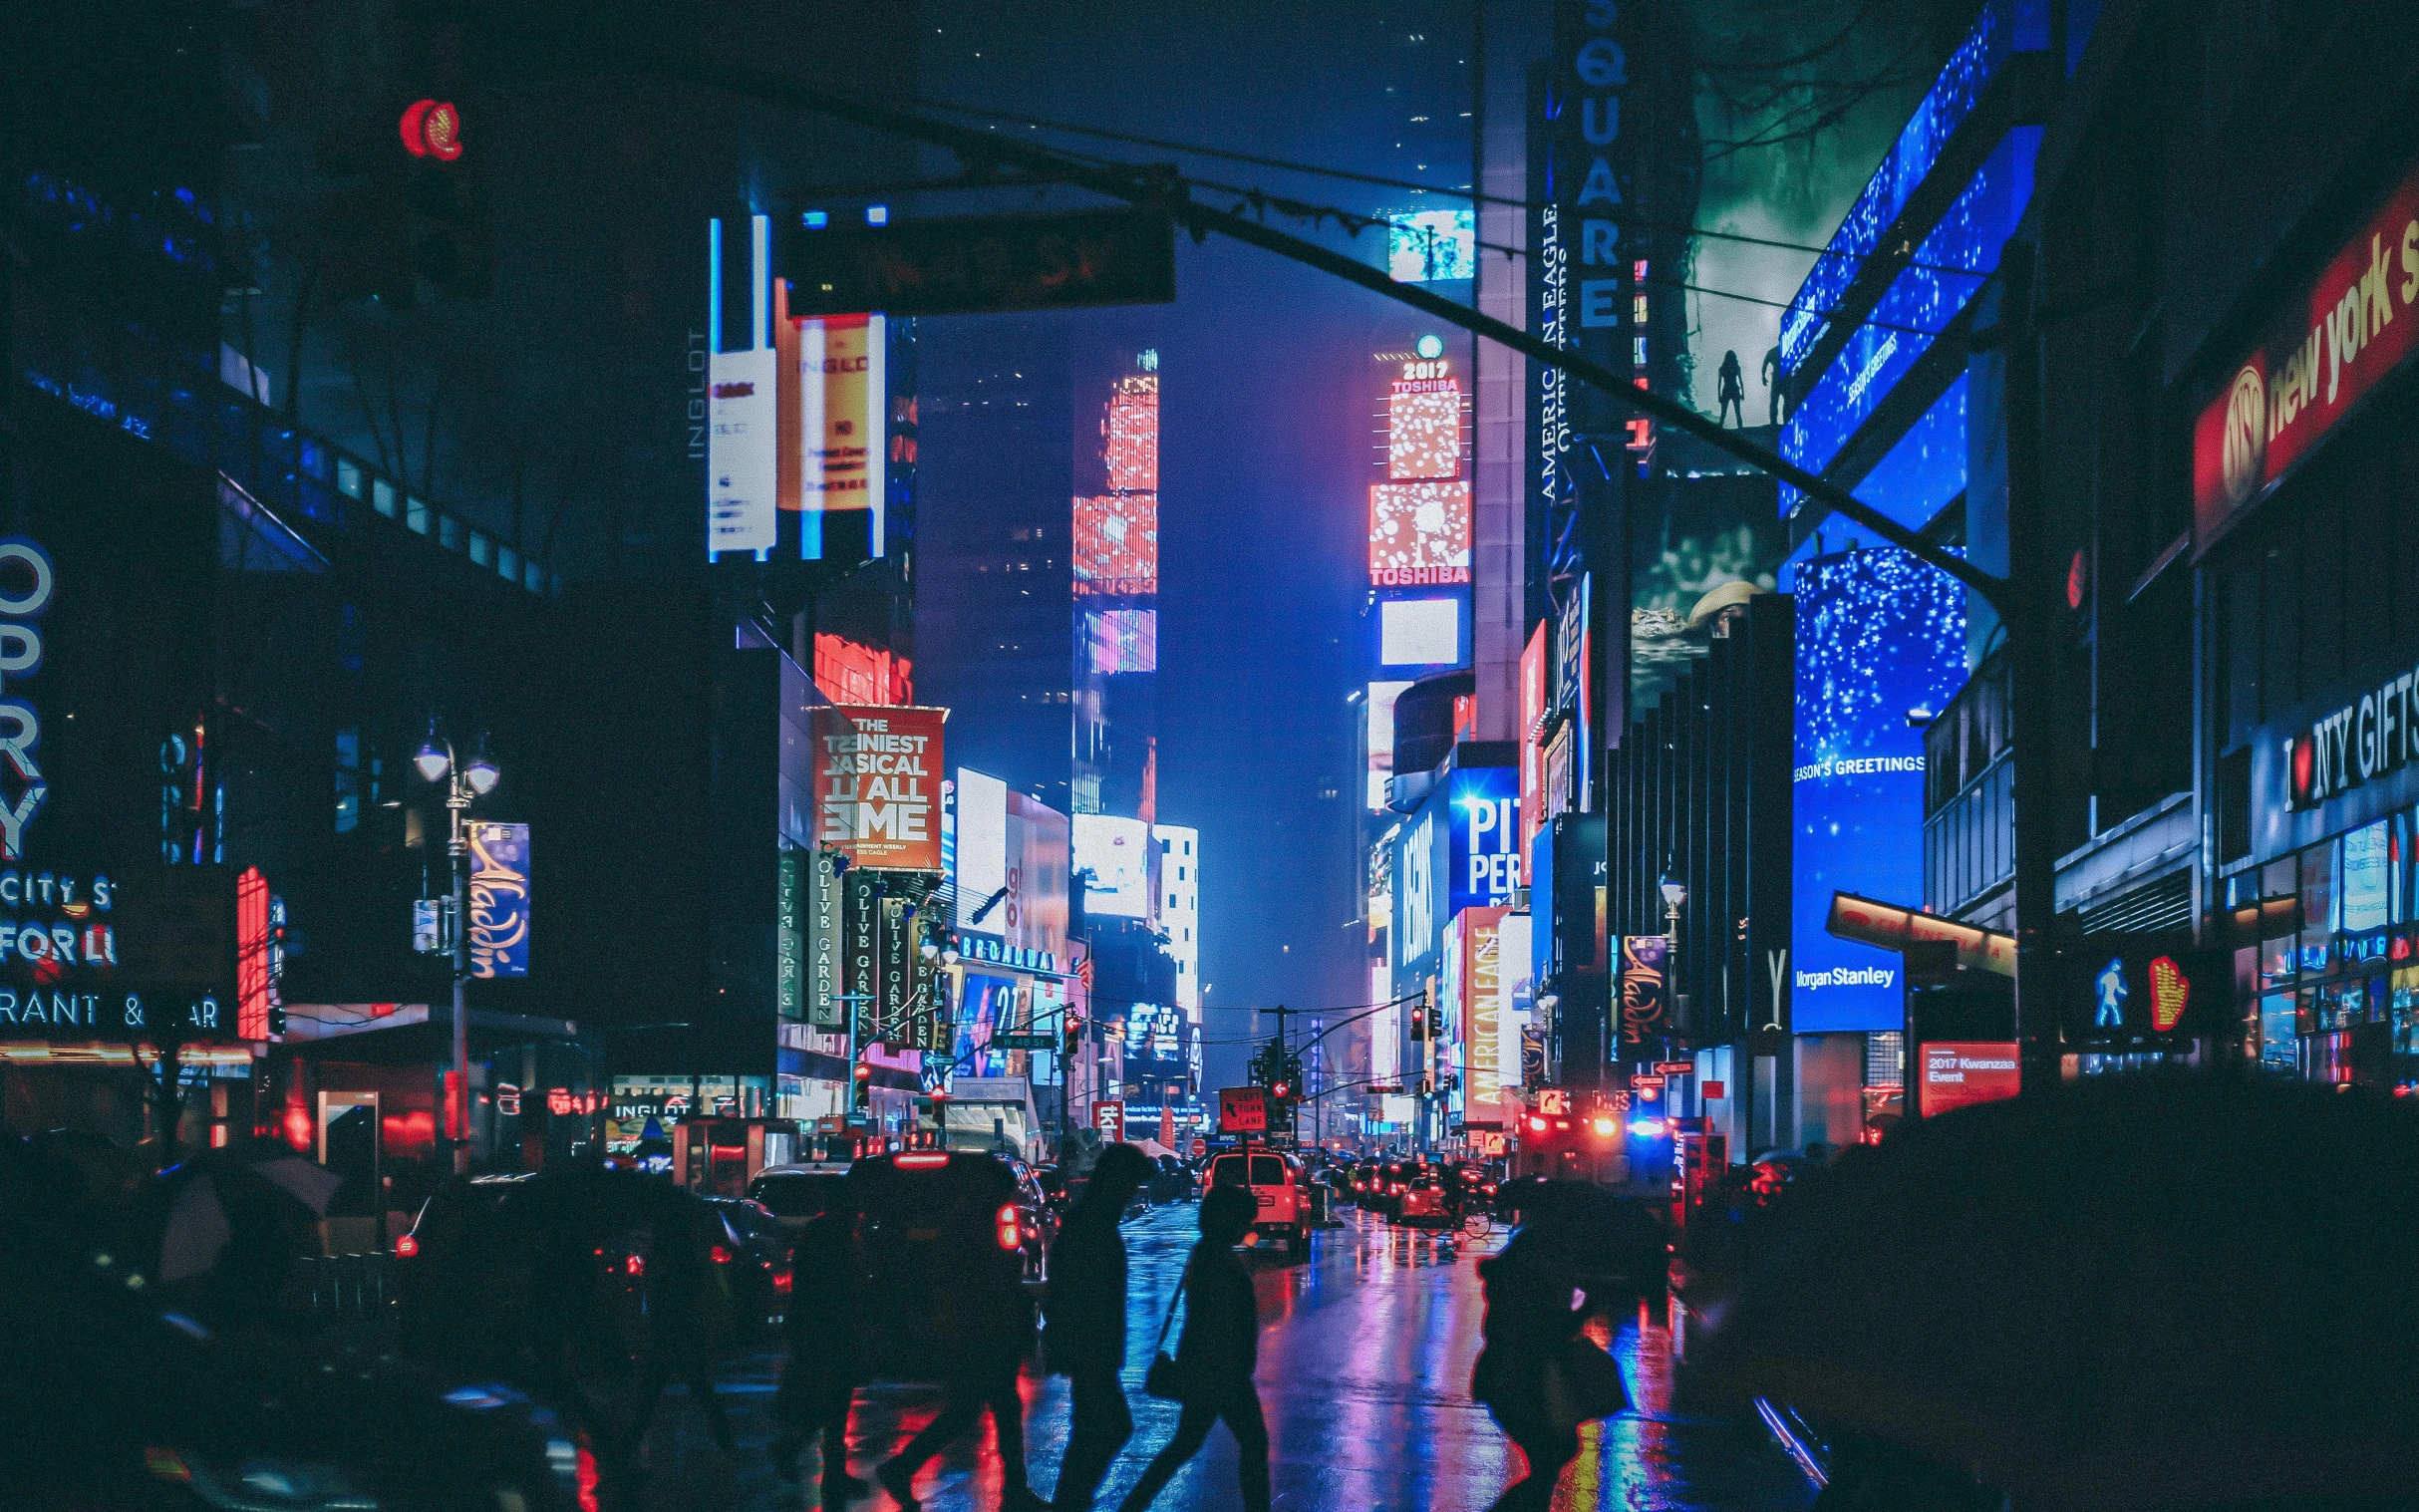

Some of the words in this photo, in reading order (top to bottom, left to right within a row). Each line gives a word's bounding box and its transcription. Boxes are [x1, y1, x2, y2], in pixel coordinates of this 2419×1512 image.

[1543, 203, 1558, 309] EAGLE
[2268, 325, 2321, 444] new
[2326, 231, 2393, 406] york
[1402, 361, 1449, 381] 2017
[688, 330, 705, 458] INGLOT
[1391, 379, 1458, 394] TOSHIBA
[1542, 325, 1557, 500] AMERICN
[1369, 565, 1471, 587] TOSHIBA
[855, 718, 888, 732] THE
[857, 754, 928, 776] SICAL
[2313, 705, 2353, 800] NY
[1794, 761, 1832, 783] SEASON'S
[1835, 756, 1926, 776] GREETINGS
[866, 775, 928, 801] ALL
[94, 881, 117, 905] S
[817, 859, 833, 930] OLIVE
[857, 884, 871, 948] OLIVE
[0, 926, 75, 961] FOR
[889, 906, 902, 964] OLIVE
[816, 937, 833, 1021] GARDEN
[1796, 970, 1831, 991] Morgan
[1832, 966, 1895, 989] Stanley
[1003, 1038, 1013, 1047] W
[1034, 1038, 1045, 1047] St
[1473, 995, 1500, 1104] AMERICAN
[1929, 1058, 1958, 1069] 2017
[1960, 1058, 2015, 1069] Kwanzaa
[1929, 1070, 1965, 1082] Event
